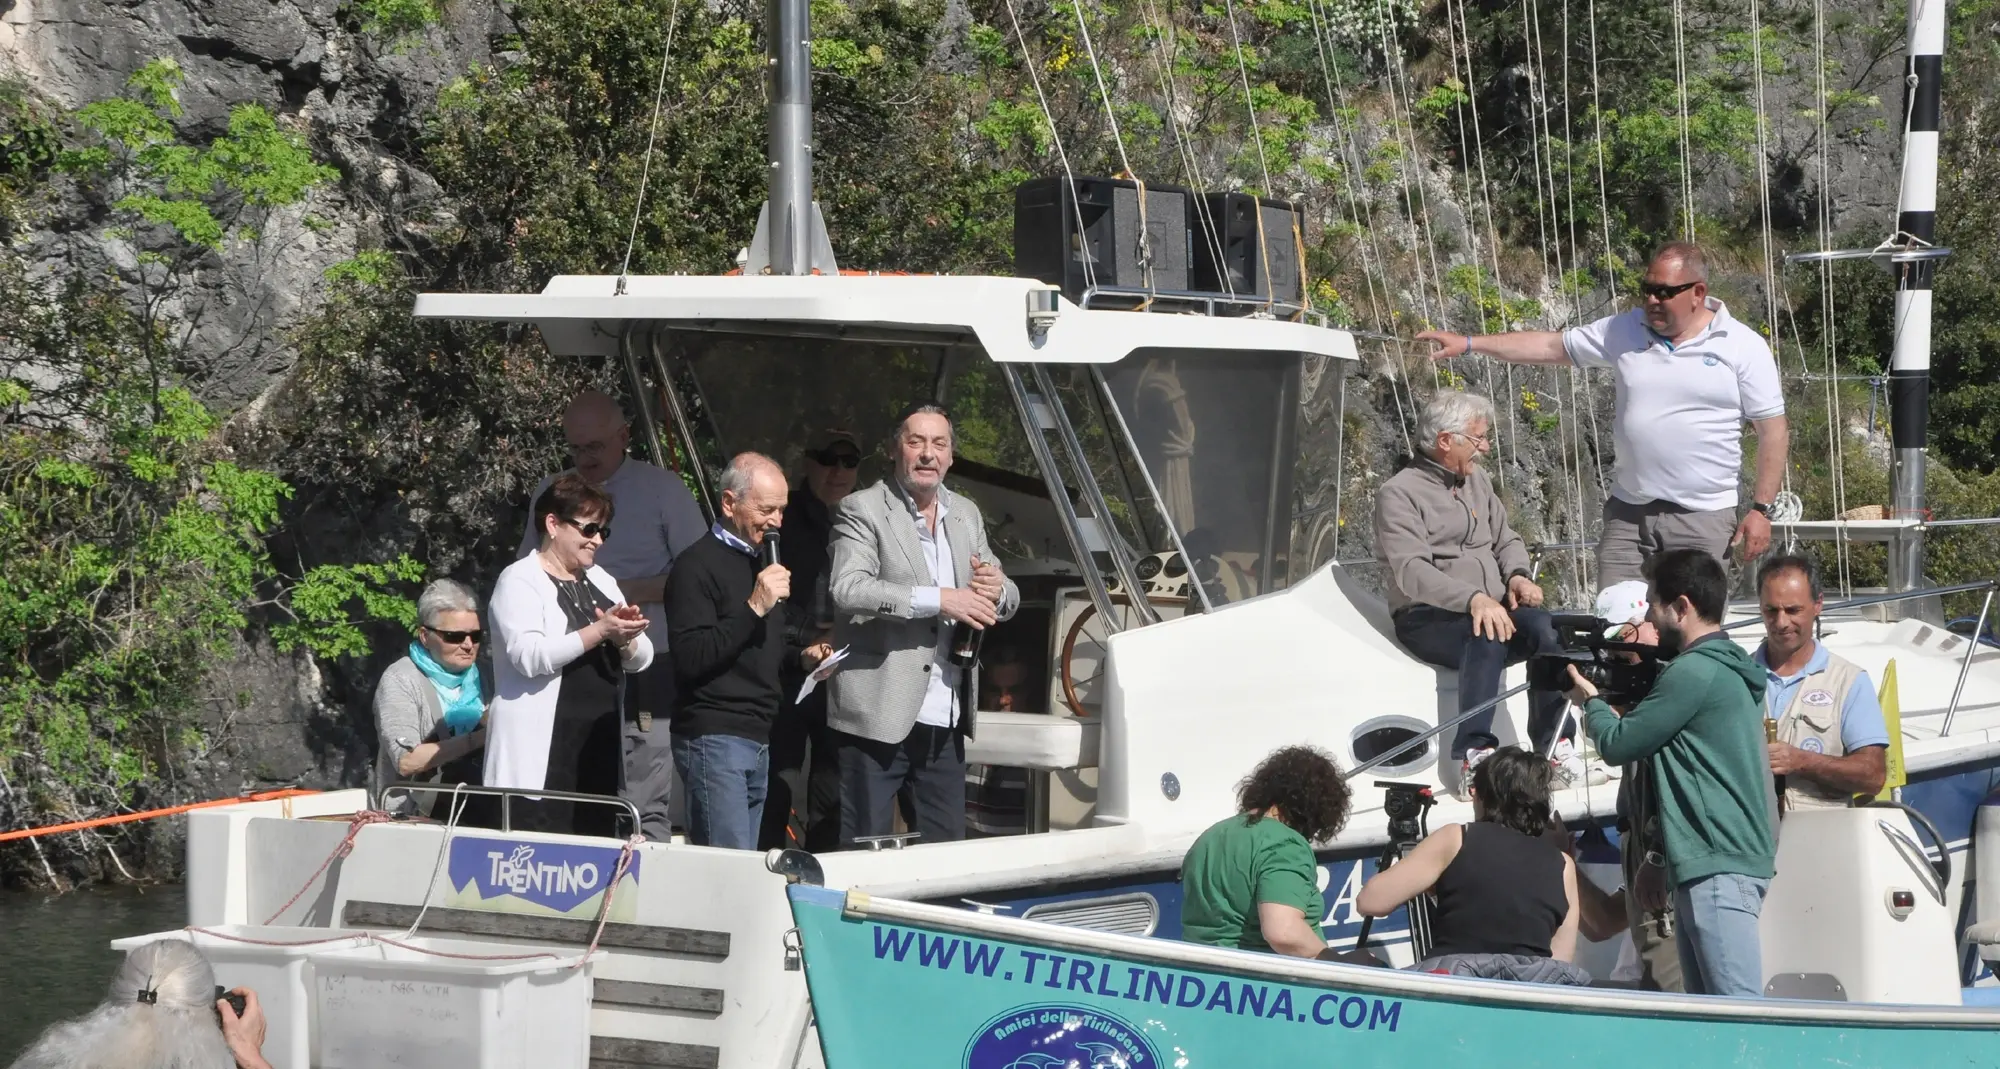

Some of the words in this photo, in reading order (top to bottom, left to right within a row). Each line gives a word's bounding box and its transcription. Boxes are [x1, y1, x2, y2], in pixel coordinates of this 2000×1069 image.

[487, 851, 599, 896] TRENTINO
[872, 925, 1402, 1033] WWW.TIRLINDANA.COM
[994, 1013, 1036, 1041] Amici
[1040, 1011, 1079, 1025] della
[1083, 1014, 1144, 1063] Tirlindana
